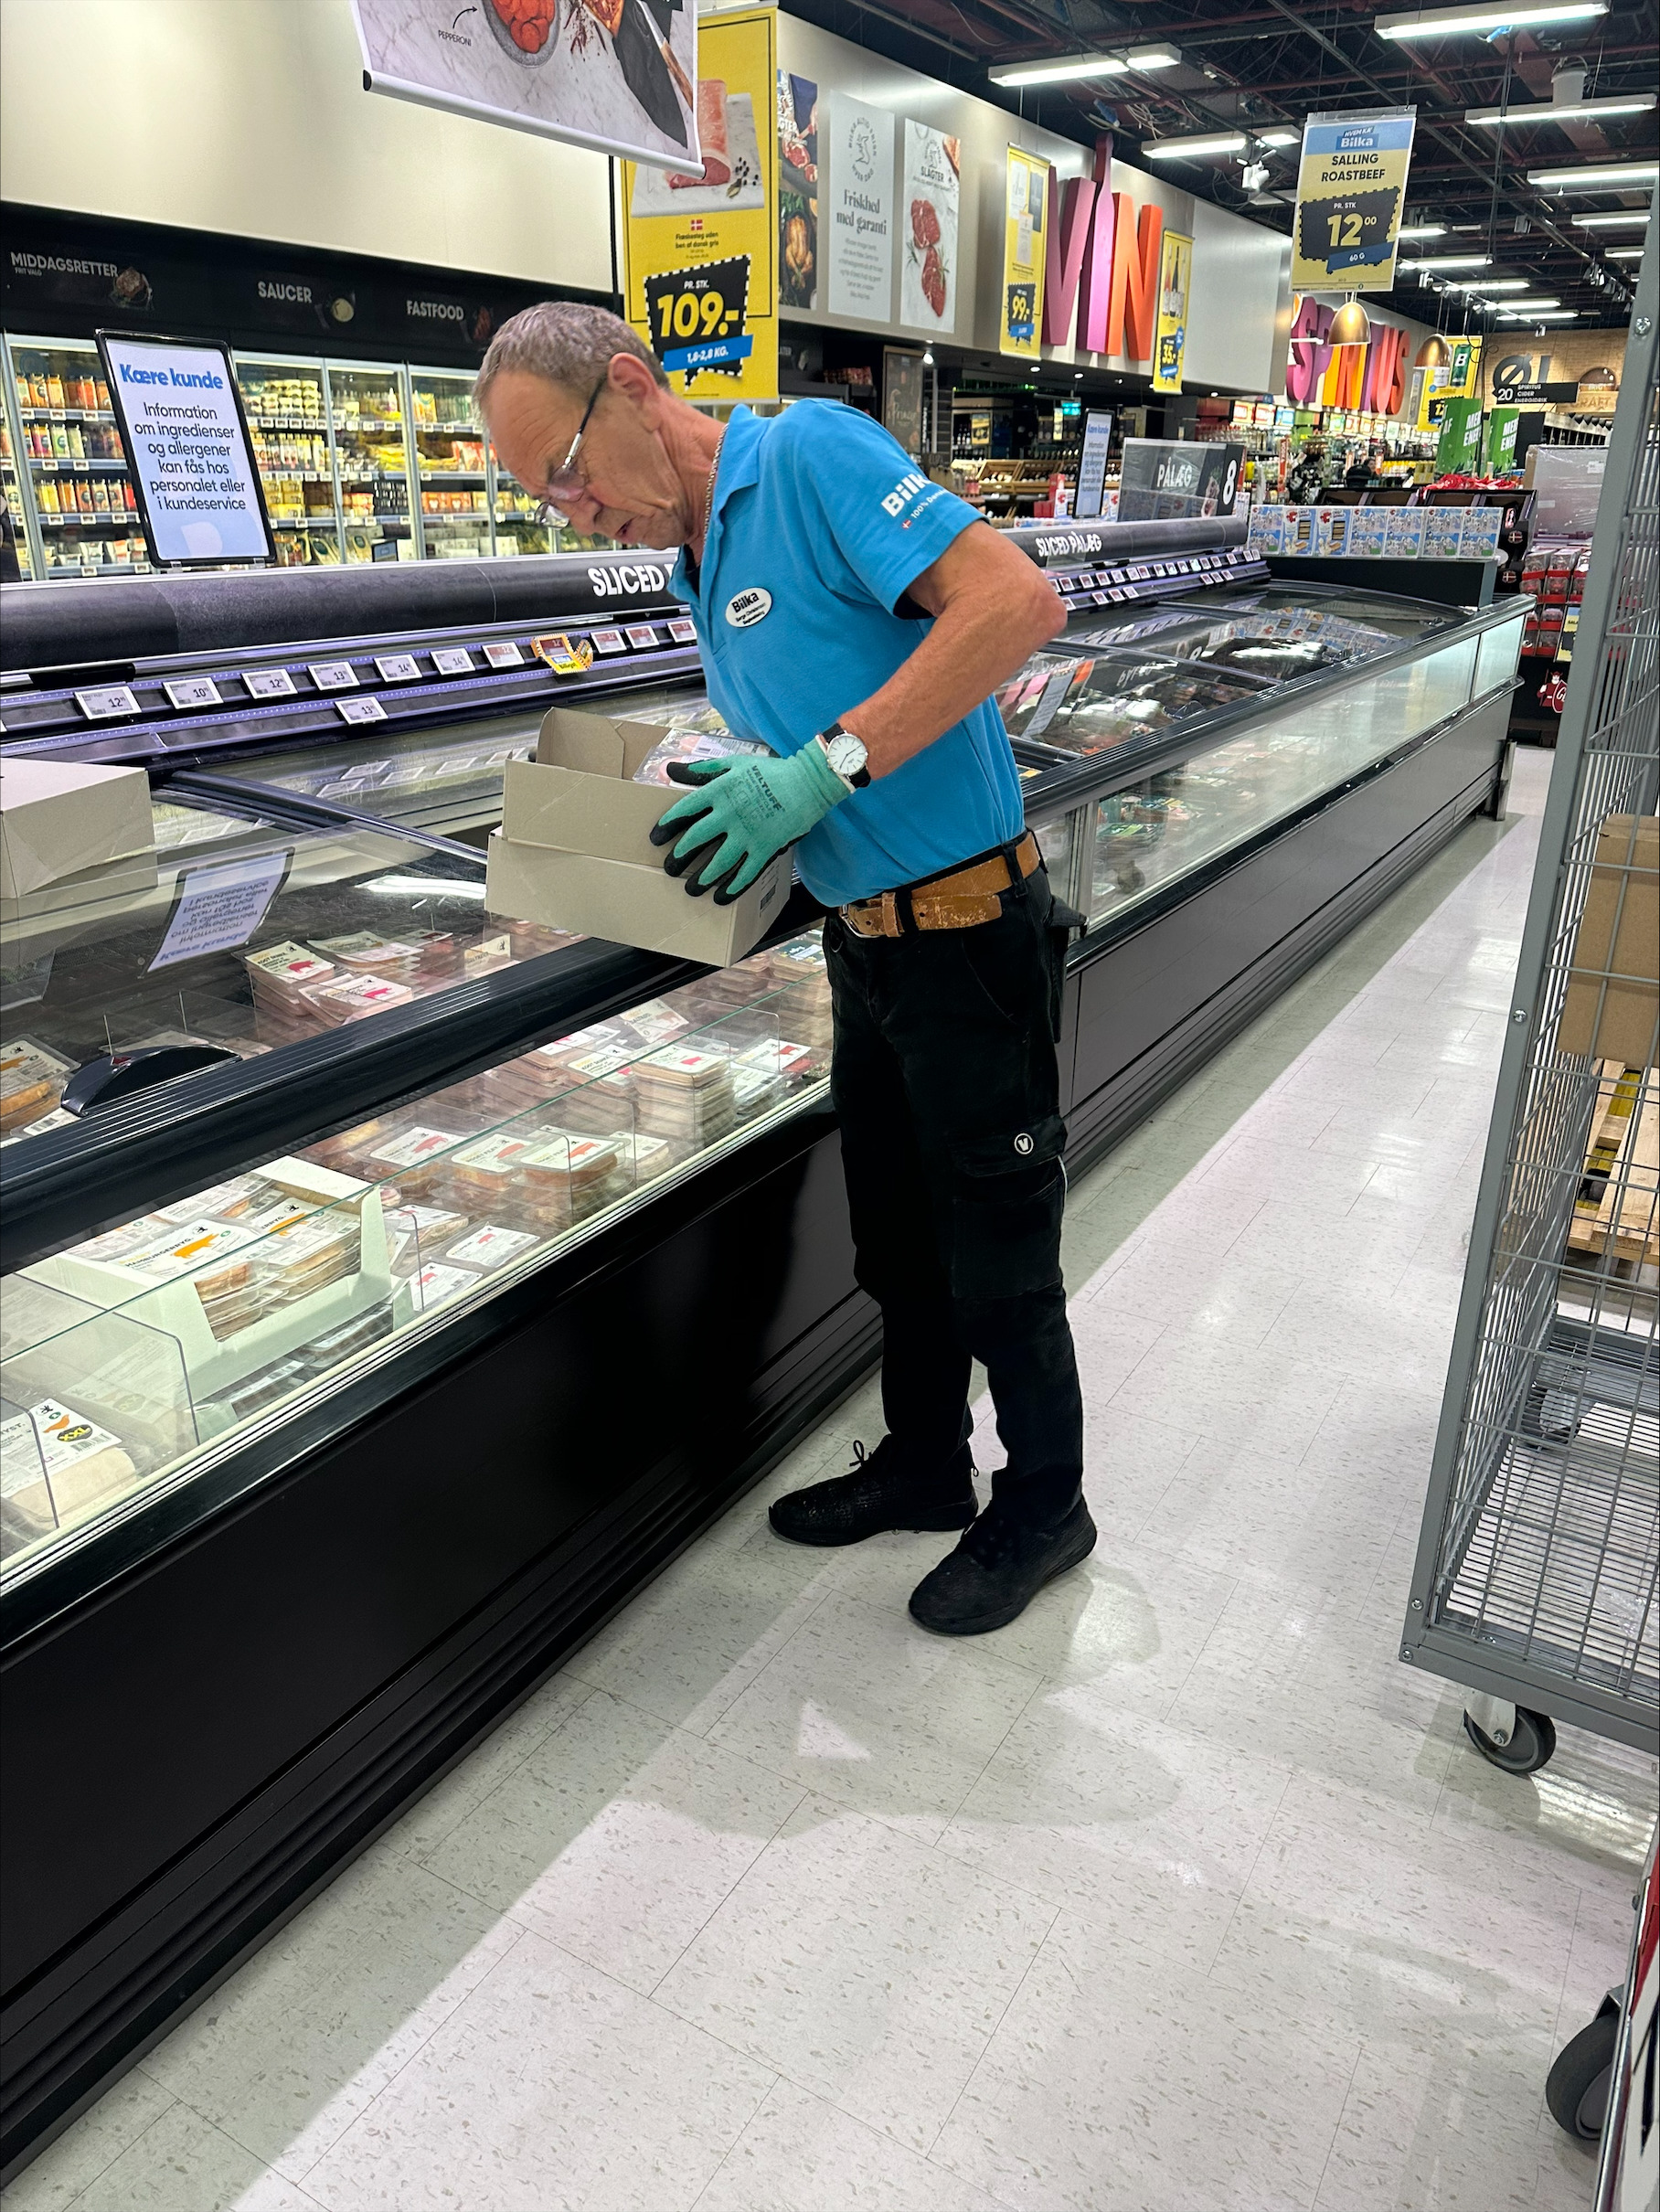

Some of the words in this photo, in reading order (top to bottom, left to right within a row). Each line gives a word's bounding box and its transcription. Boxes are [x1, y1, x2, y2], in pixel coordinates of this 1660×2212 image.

[438, 30, 472, 47] PEPPERONI
[1341, 136, 1374, 147] Bilka
[1332, 154, 1378, 165] SALLING
[1321, 168, 1386, 182] ROASTBEEF
[844, 189, 880, 214] Friskhed
[836, 211, 855, 227] med
[857, 217, 887, 235] garanti
[1042, 133, 1164, 361] VIN
[10, 251, 118, 277] MIDDAGSRETTER
[258, 281, 313, 303] SAUCER
[406, 300, 464, 320] FASTFOOD
[119, 364, 168, 386] Kære
[170, 368, 224, 389] kunde
[1498, 388, 1513, 401] 20
[144, 402, 218, 420] Information
[134, 423, 156, 436] om
[157, 421, 235, 440] ingredienser
[148, 443, 166, 458] og
[168, 441, 231, 459] allergener
[157, 459, 183, 473] kan
[185, 458, 205, 474] fås
[208, 460, 229, 474] hos
[1156, 457, 1192, 487] PÅLÆG
[150, 478, 218, 495] personalet
[219, 479, 245, 493] eller
[1223, 459, 1237, 505] 8
[157, 496, 163, 510] i
[164, 496, 246, 511] kundeservice
[881, 473, 931, 517] Bilk
[910, 501, 930, 519] 100%
[1036, 537, 1069, 557] SLICED
[588, 564, 665, 597] SLICED
[731, 592, 760, 613] Bilka
[58, 1426, 92, 1441] XXL
